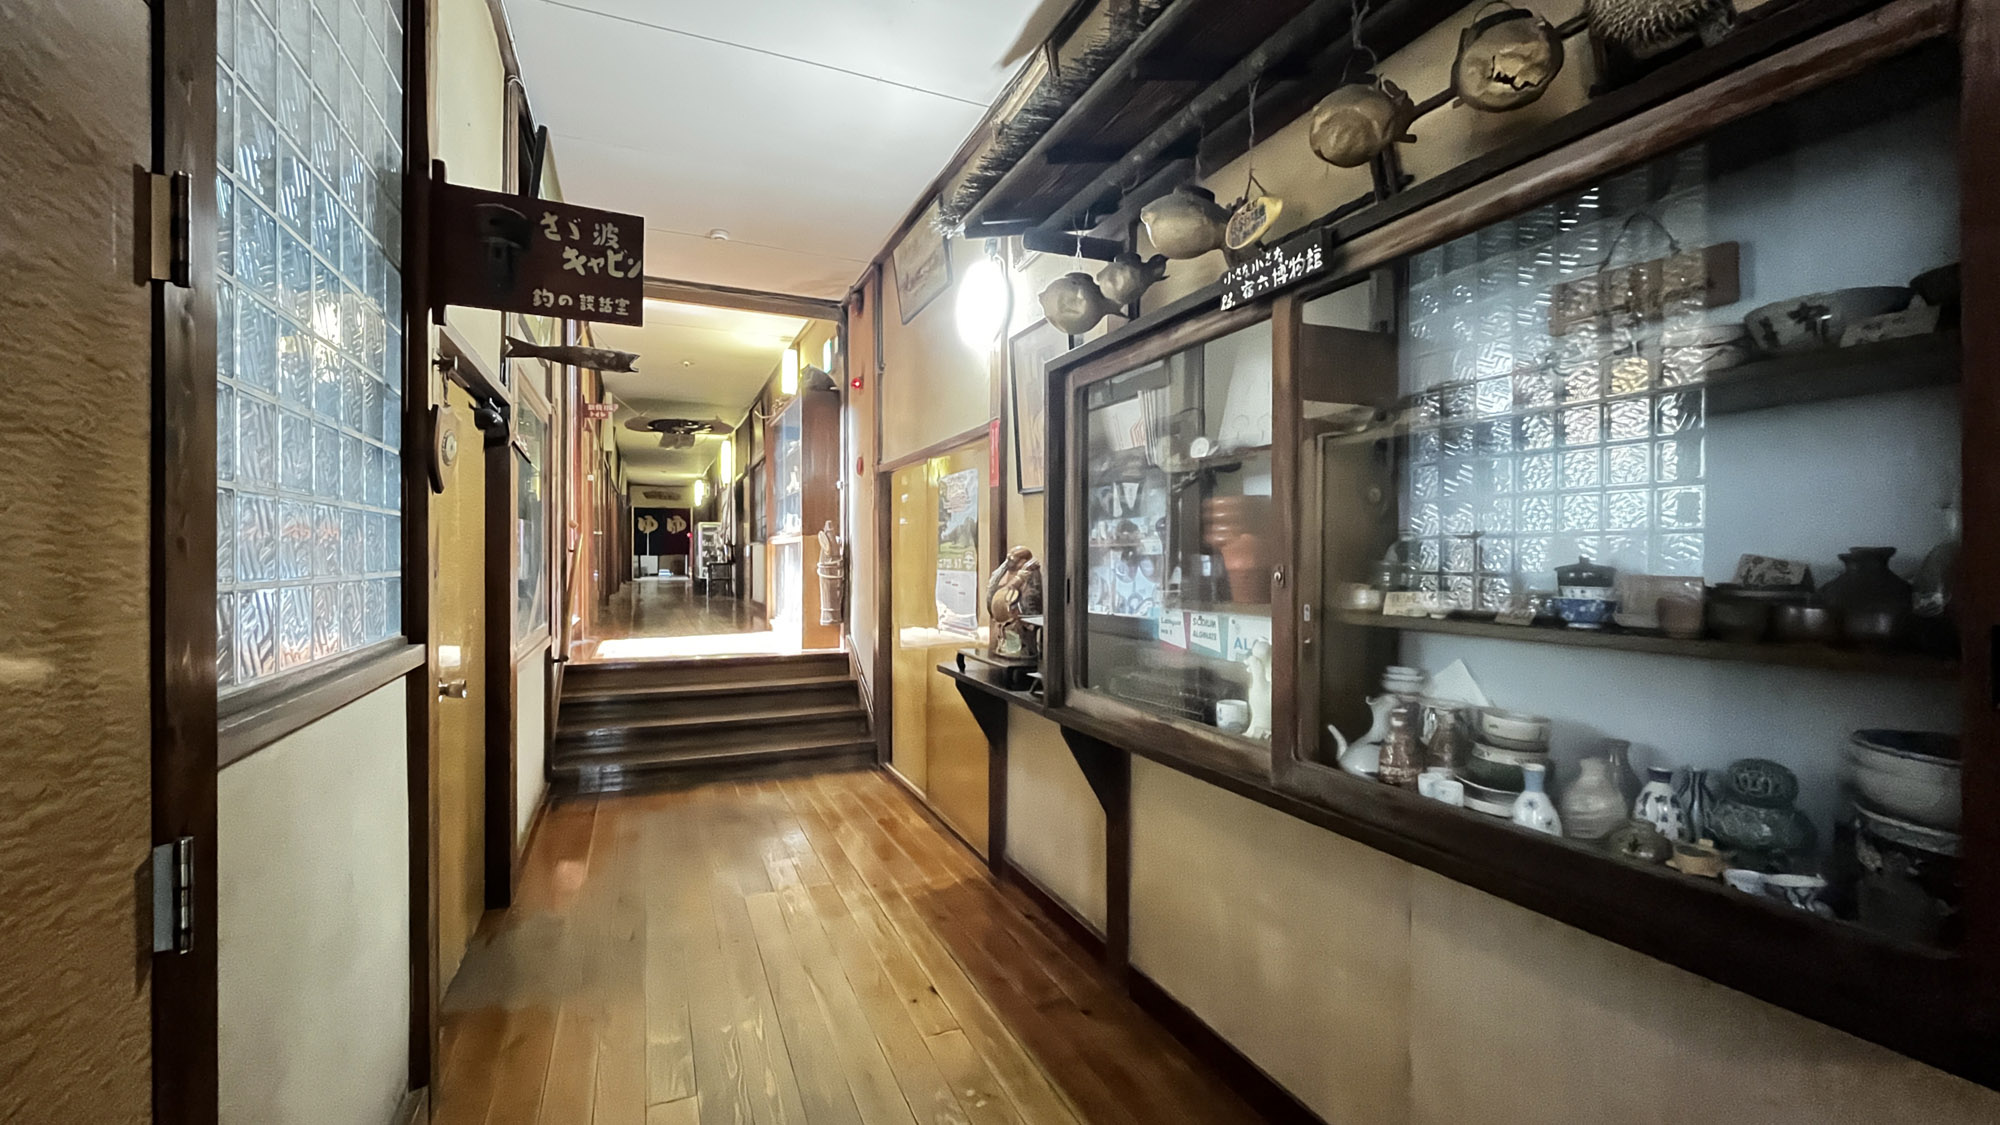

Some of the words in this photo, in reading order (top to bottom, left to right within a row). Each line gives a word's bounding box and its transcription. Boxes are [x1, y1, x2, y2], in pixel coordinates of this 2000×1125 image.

[562, 246, 642, 278] キャビン
[532, 288, 630, 316] 釣の談話室
